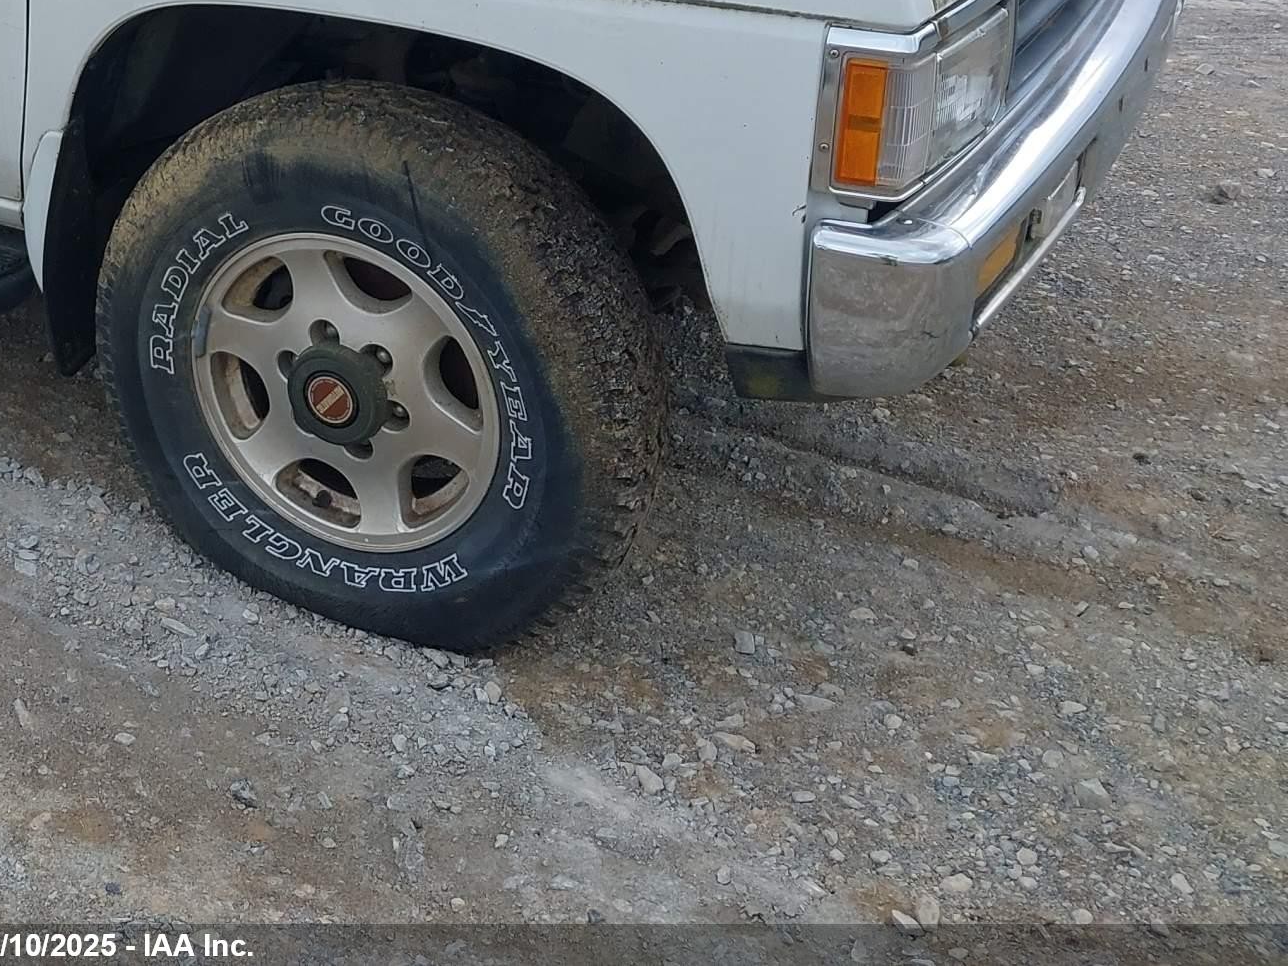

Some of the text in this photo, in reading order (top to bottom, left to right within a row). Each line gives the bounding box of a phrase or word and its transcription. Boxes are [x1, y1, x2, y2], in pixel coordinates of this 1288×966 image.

[150, 212, 249, 375] RADIAL
[320, 204, 533, 510] GOODYEAR
[182, 453, 468, 593] WRANGLER
